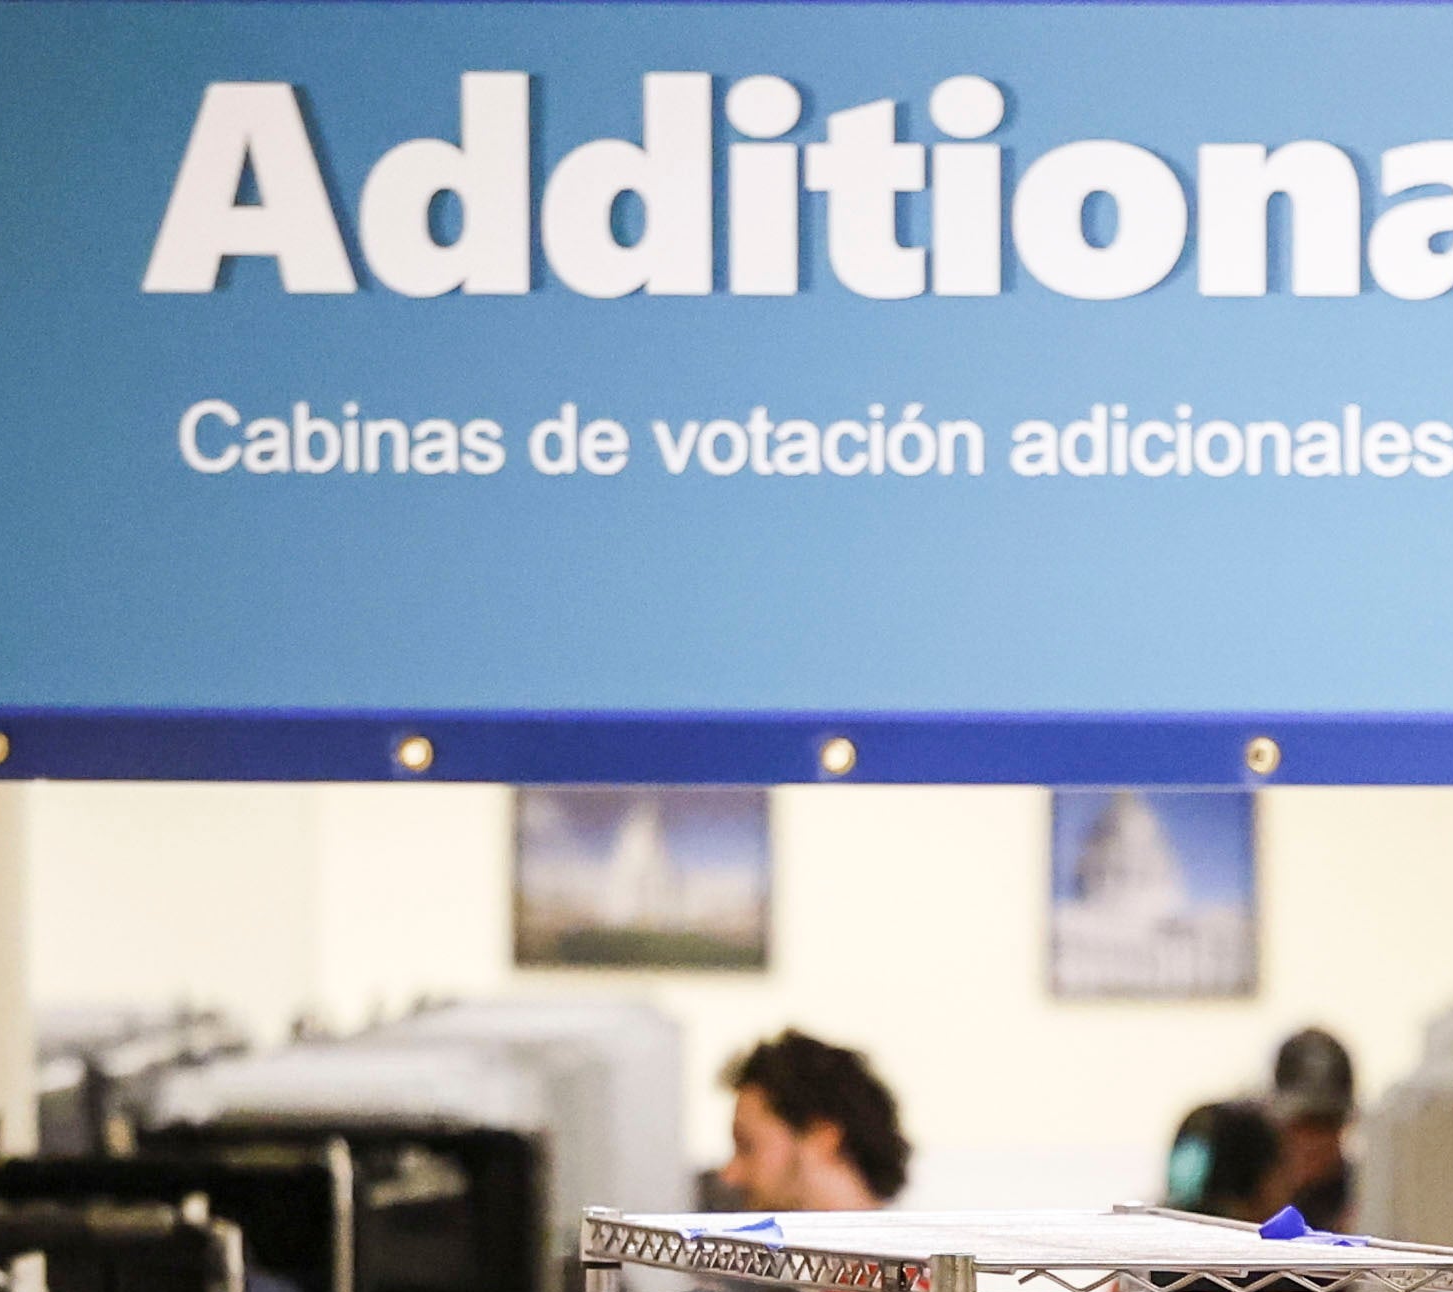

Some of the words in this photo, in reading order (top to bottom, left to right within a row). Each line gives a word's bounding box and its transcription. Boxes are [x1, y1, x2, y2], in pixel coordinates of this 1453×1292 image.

[178, 400, 506, 476] Cabinas
[528, 402, 630, 476] de
[652, 401, 985, 478] votación
